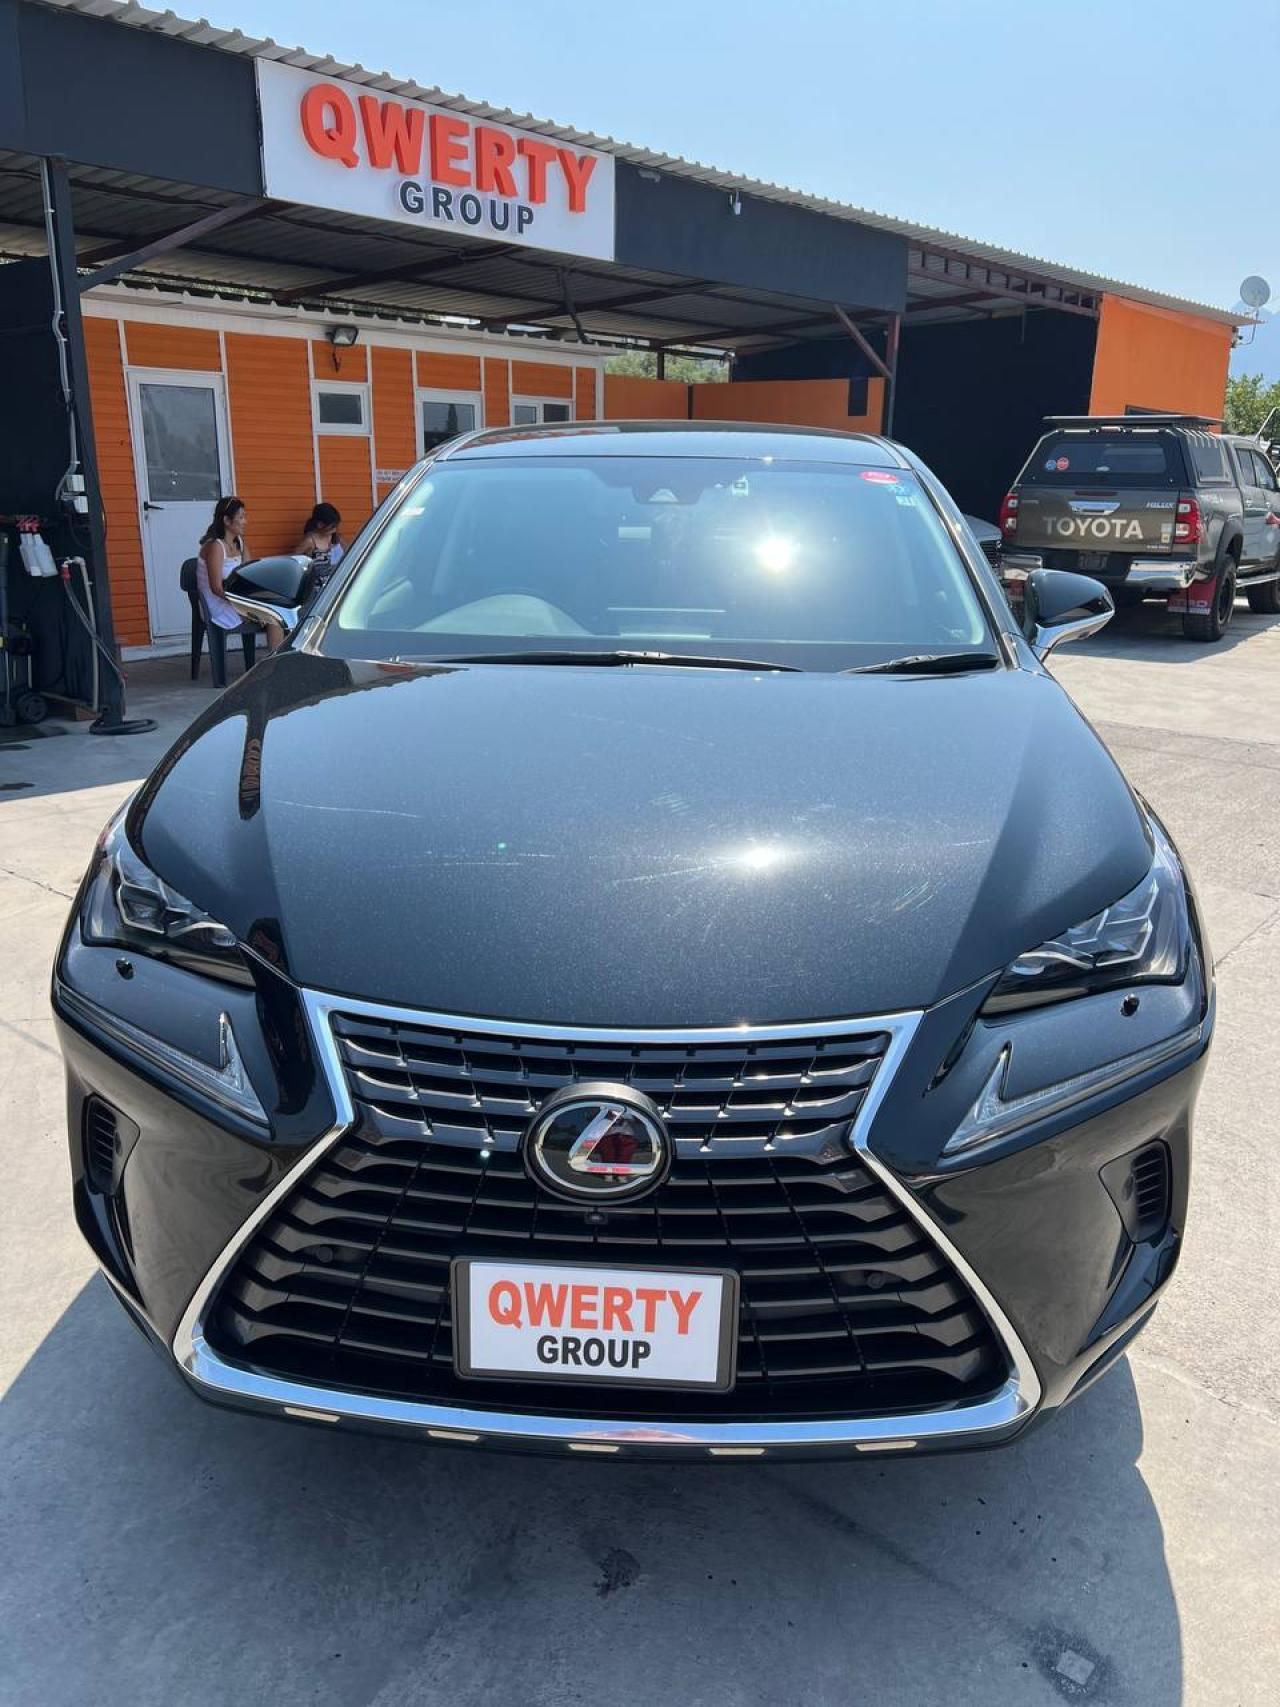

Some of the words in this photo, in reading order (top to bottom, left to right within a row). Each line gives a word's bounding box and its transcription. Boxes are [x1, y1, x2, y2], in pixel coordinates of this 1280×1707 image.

[300, 83, 598, 214] QWERTY
[398, 180, 535, 235] GROUP
[1042, 516, 1144, 540] TOYOTA
[488, 1280, 703, 1335] QWERTY
[536, 1335, 651, 1369] GROUP
